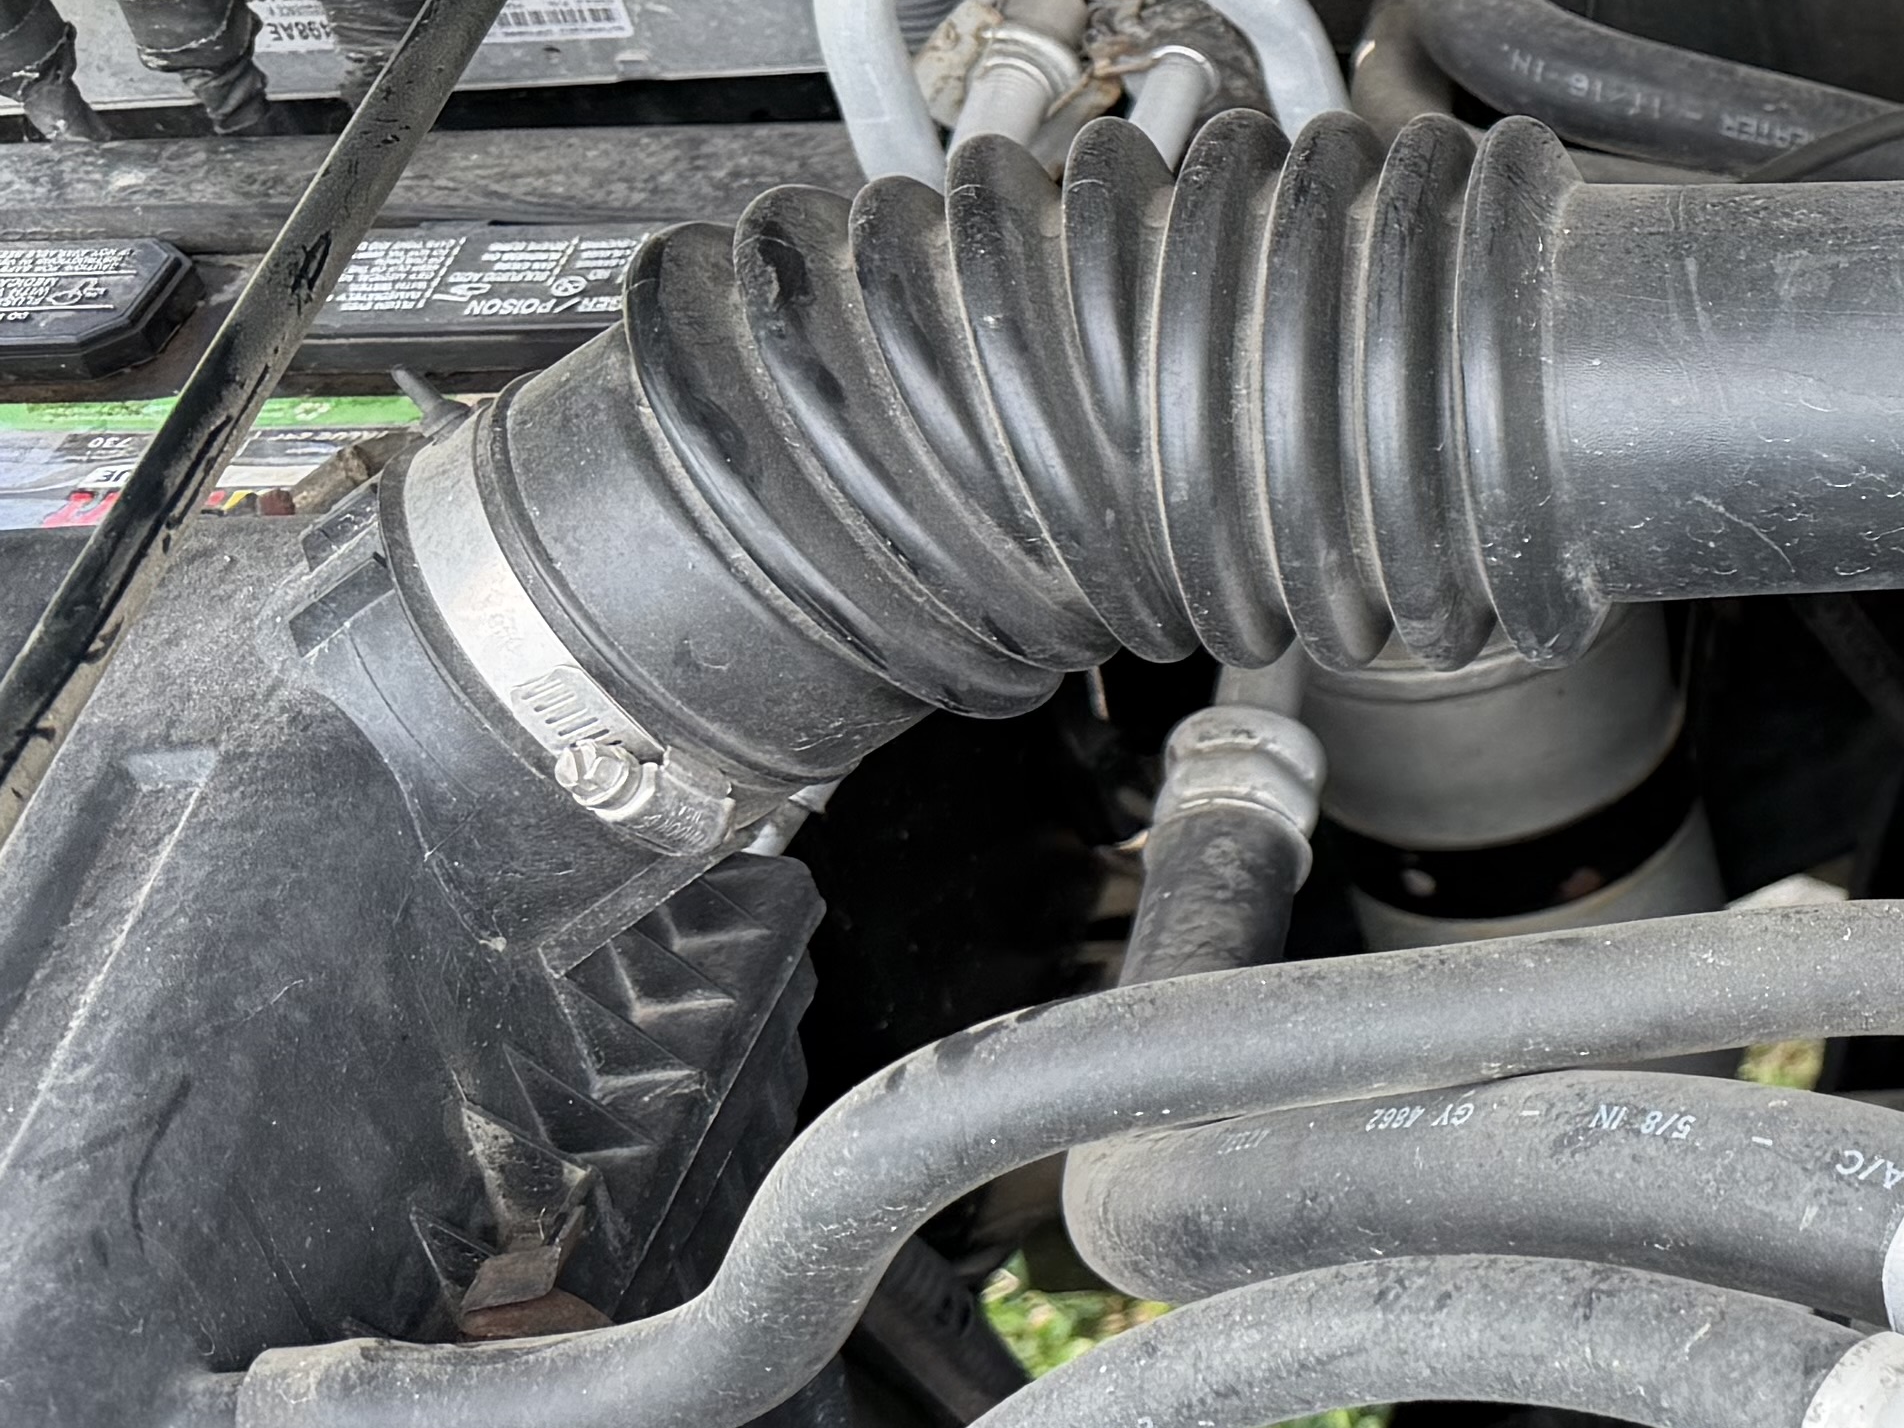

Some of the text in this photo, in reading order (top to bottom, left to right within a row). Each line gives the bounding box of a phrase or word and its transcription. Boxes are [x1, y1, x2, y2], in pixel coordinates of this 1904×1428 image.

[86, 436, 132, 448] 730
[1364, 1106, 1420, 1133] 4862
[1431, 1102, 1476, 1130] GY
[1590, 1102, 1628, 1132] IN
[1640, 1110, 1698, 1141] 5/8
